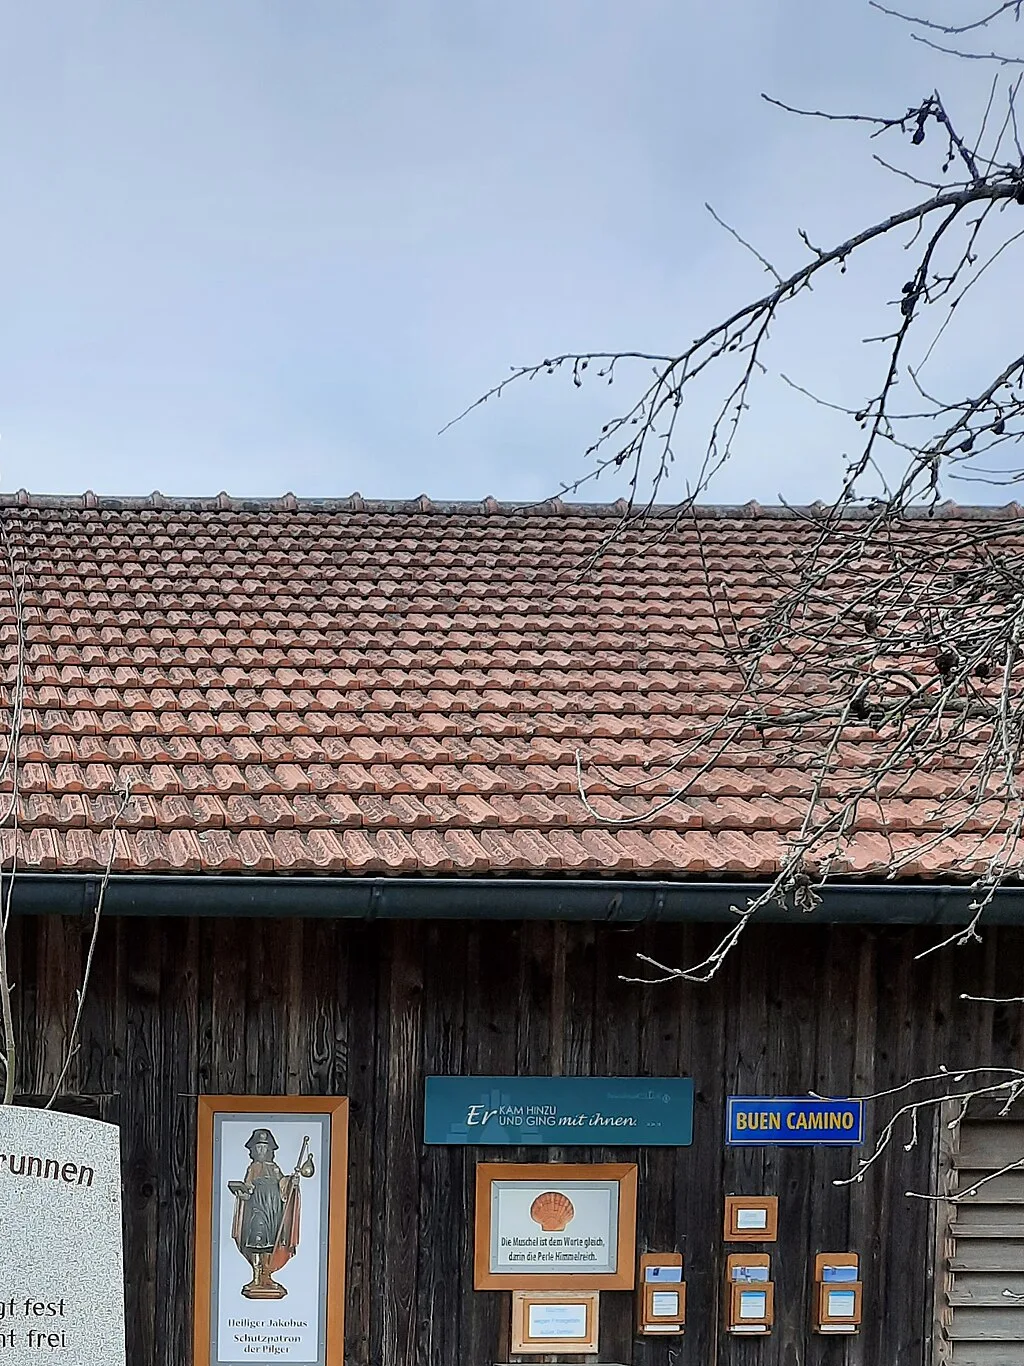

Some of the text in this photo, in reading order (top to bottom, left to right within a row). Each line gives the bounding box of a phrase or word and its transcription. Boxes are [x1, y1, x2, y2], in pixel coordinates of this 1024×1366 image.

[466, 1104, 557, 1126] Er KAM HINZU
[499, 1116, 523, 1126] UND
[526, 1116, 556, 1126] GING
[558, 1114, 588, 1126] mit
[589, 1112, 637, 1127] ihnen.
[736, 1112, 854, 1130] BUEN CAMINO
[501, 1236, 512, 1247] Die
[513, 1236, 539, 1247] Muschel
[540, 1236, 548, 1247] ist
[549, 1236, 563, 1247] dem
[564, 1236, 584, 1247] Worte
[508, 1251, 598, 1261] darin die Perle Himmelreich.
[25, 1297, 66, 1317] fest
[228, 1318, 308, 1329] Heiliger Jakobus
[26, 1329, 67, 1348] frei
[233, 1333, 301, 1344] Schutzpatron
[243, 1344, 290, 1355] der Pilger
